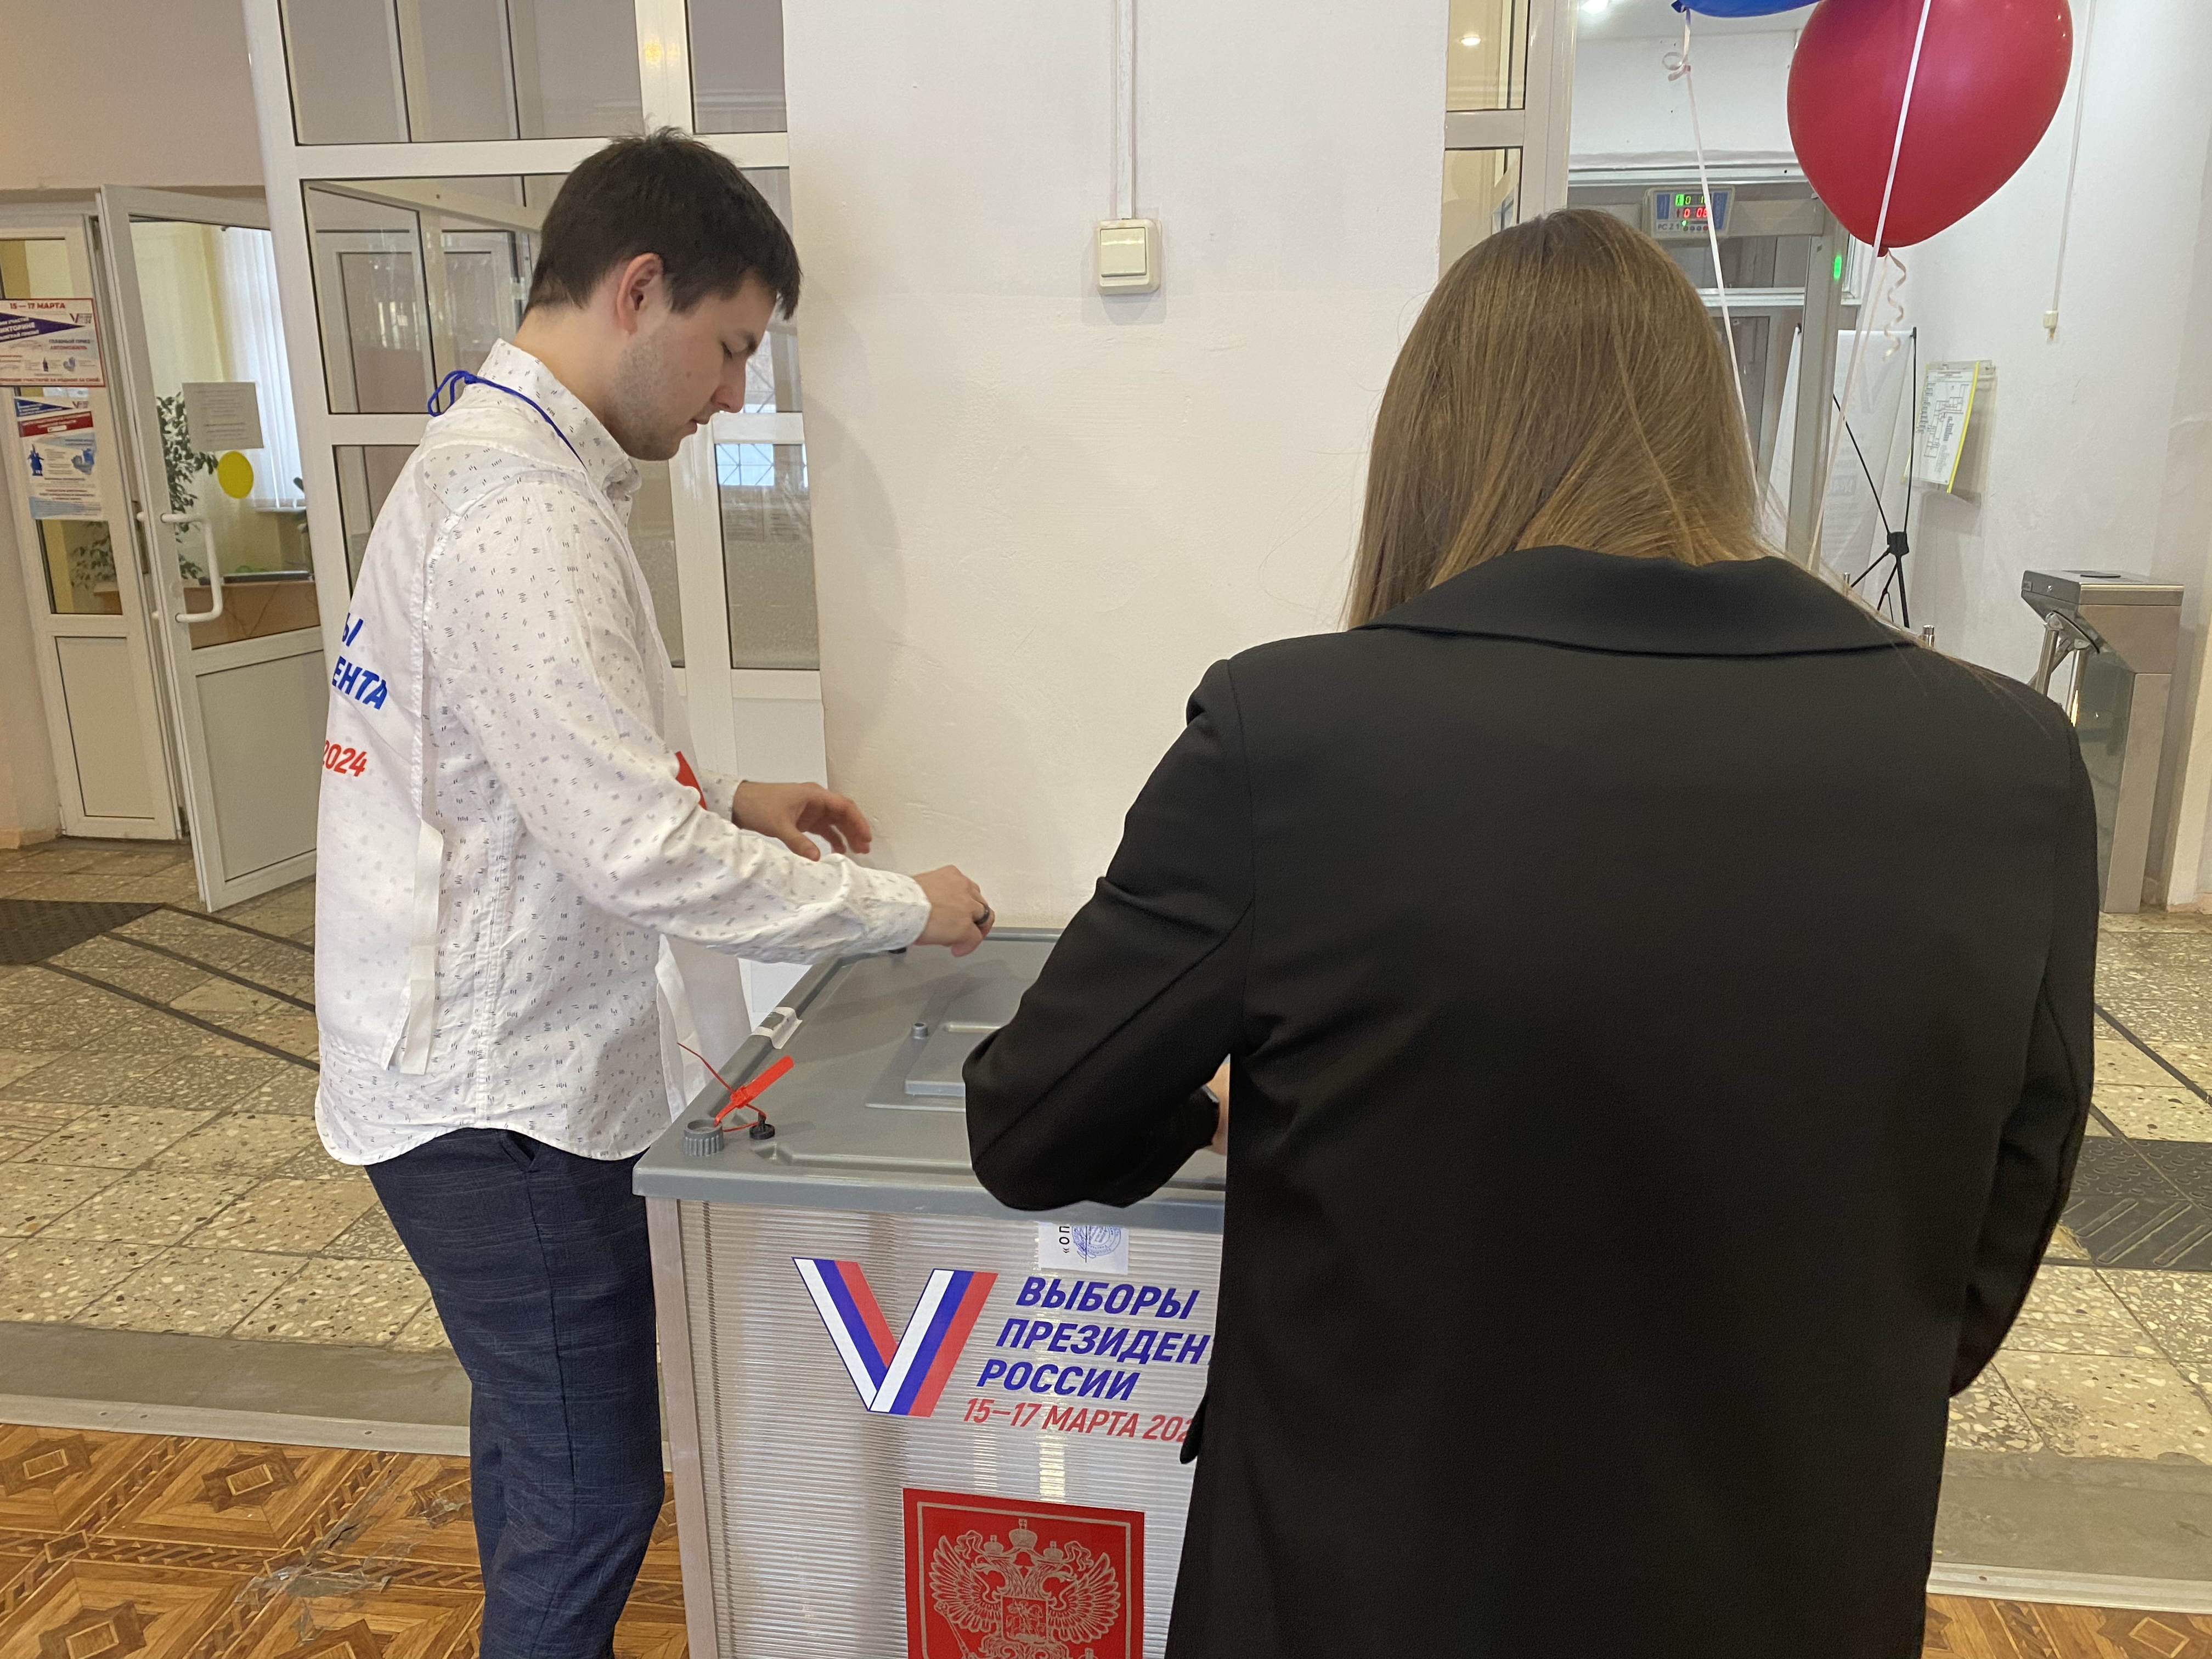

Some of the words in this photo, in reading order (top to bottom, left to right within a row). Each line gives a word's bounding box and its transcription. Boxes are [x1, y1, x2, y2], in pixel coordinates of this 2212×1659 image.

[332, 656, 387, 709] ЕНТА
[1015, 1277, 1199, 1319] ВЫБОРЫ
[996, 1318, 1211, 1364] ПРЕЗИДЕН
[977, 1359, 1140, 1401] РОССИИ
[1042, 1404, 1139, 1438] МАРТА
